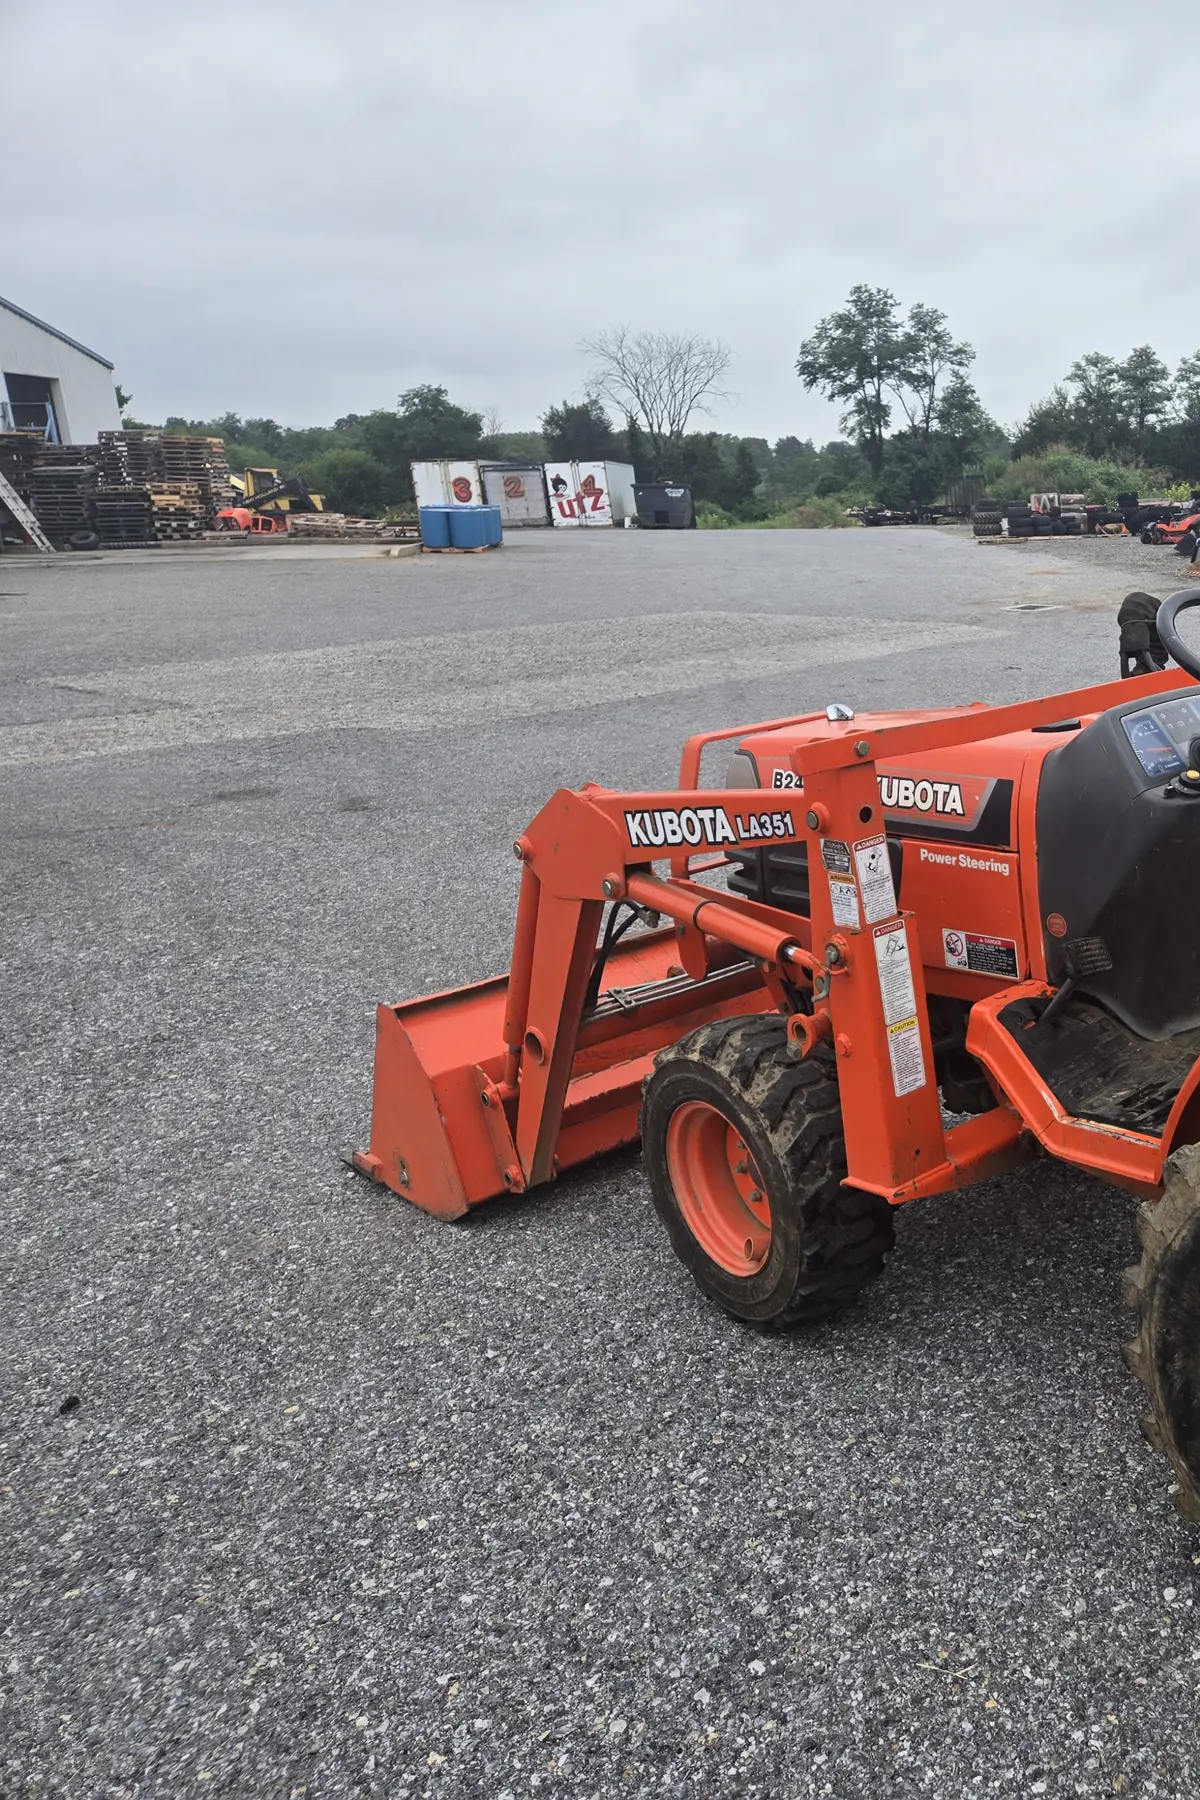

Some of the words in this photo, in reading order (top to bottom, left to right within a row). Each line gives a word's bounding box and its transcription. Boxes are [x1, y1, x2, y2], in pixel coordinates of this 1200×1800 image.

[452, 476, 473, 503] 3
[505, 476, 527, 499] 2
[877, 776, 965, 816] UBOTA
[624, 807, 739, 846] KUBOTA
[735, 811, 795, 841] LA351
[861, 836, 884, 848] DANGER
[920, 848, 957, 865] Power
[958, 853, 1010, 876] Steering
[881, 922, 902, 934] DANGER
[984, 937, 1002, 945] DANGER
[894, 1020, 915, 1031] CAUTION
